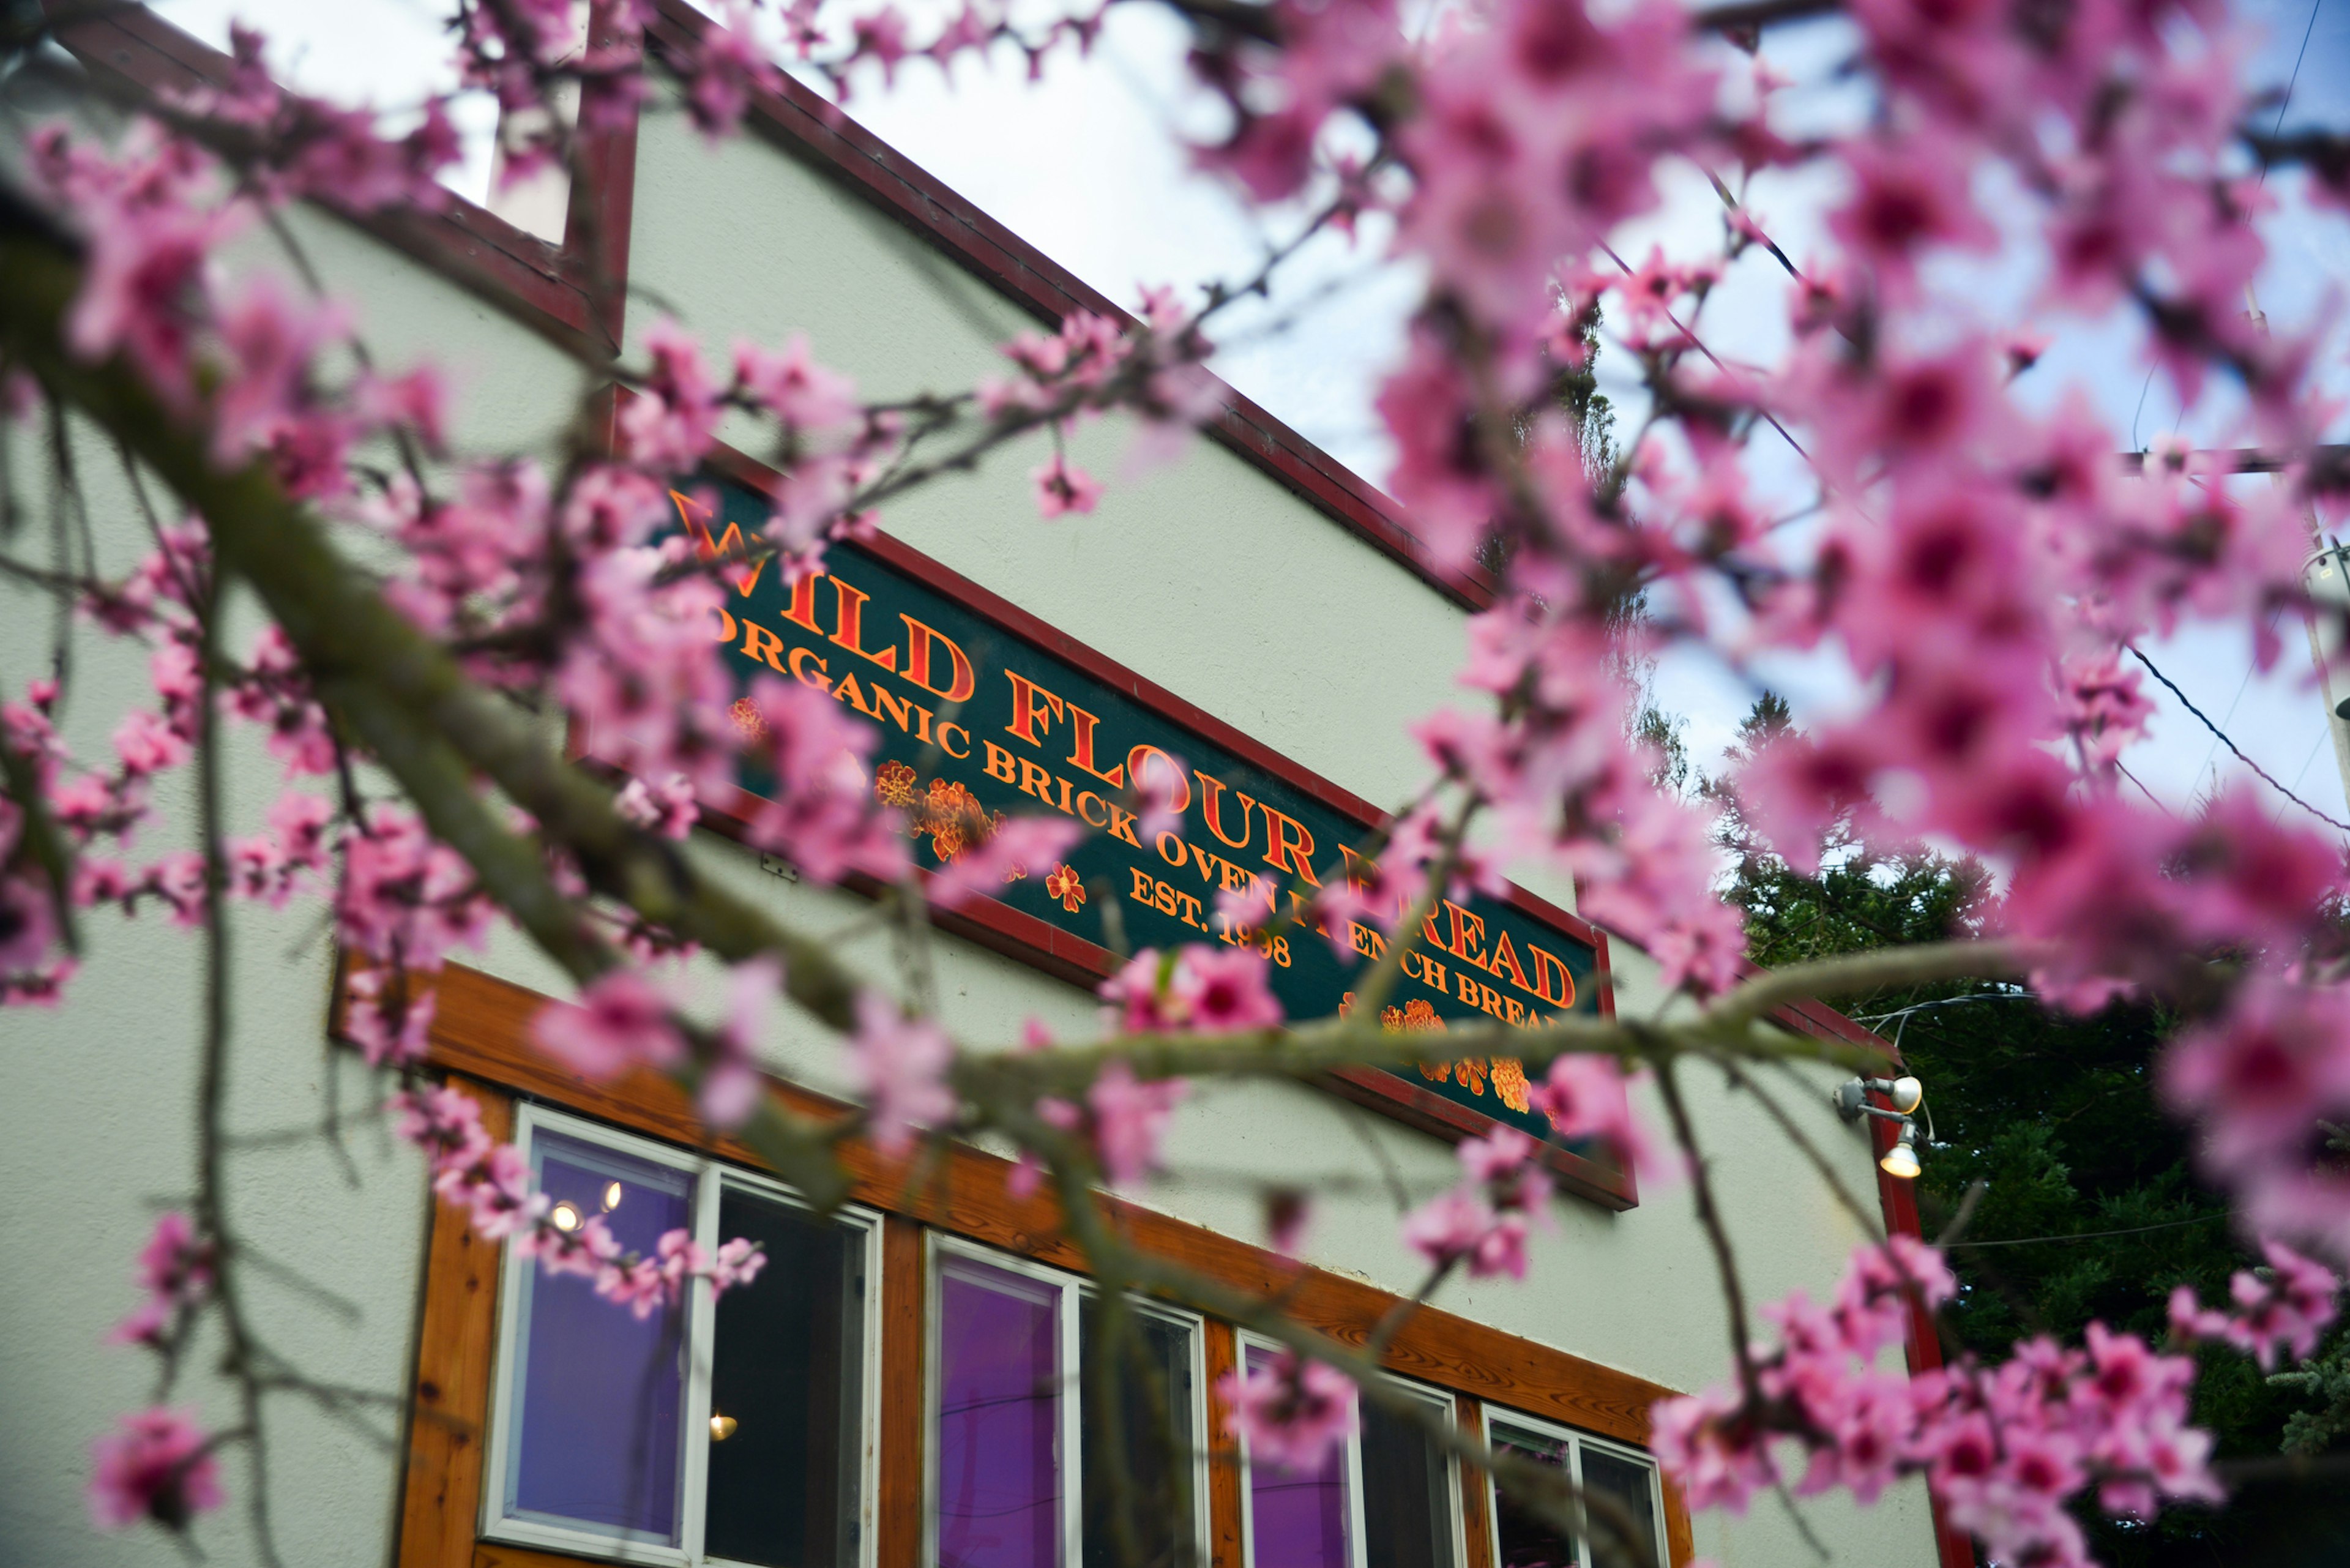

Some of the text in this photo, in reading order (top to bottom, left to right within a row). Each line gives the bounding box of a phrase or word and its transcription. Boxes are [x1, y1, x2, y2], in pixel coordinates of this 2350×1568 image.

[669, 488, 975, 703] WILD
[1004, 668, 1324, 889] FLOUR
[983, 740, 1142, 849] BRICK
[1155, 831, 1277, 914] OVEN
[1288, 890, 1450, 994] FENCH
[1130, 867, 1292, 968] EST. 1998
